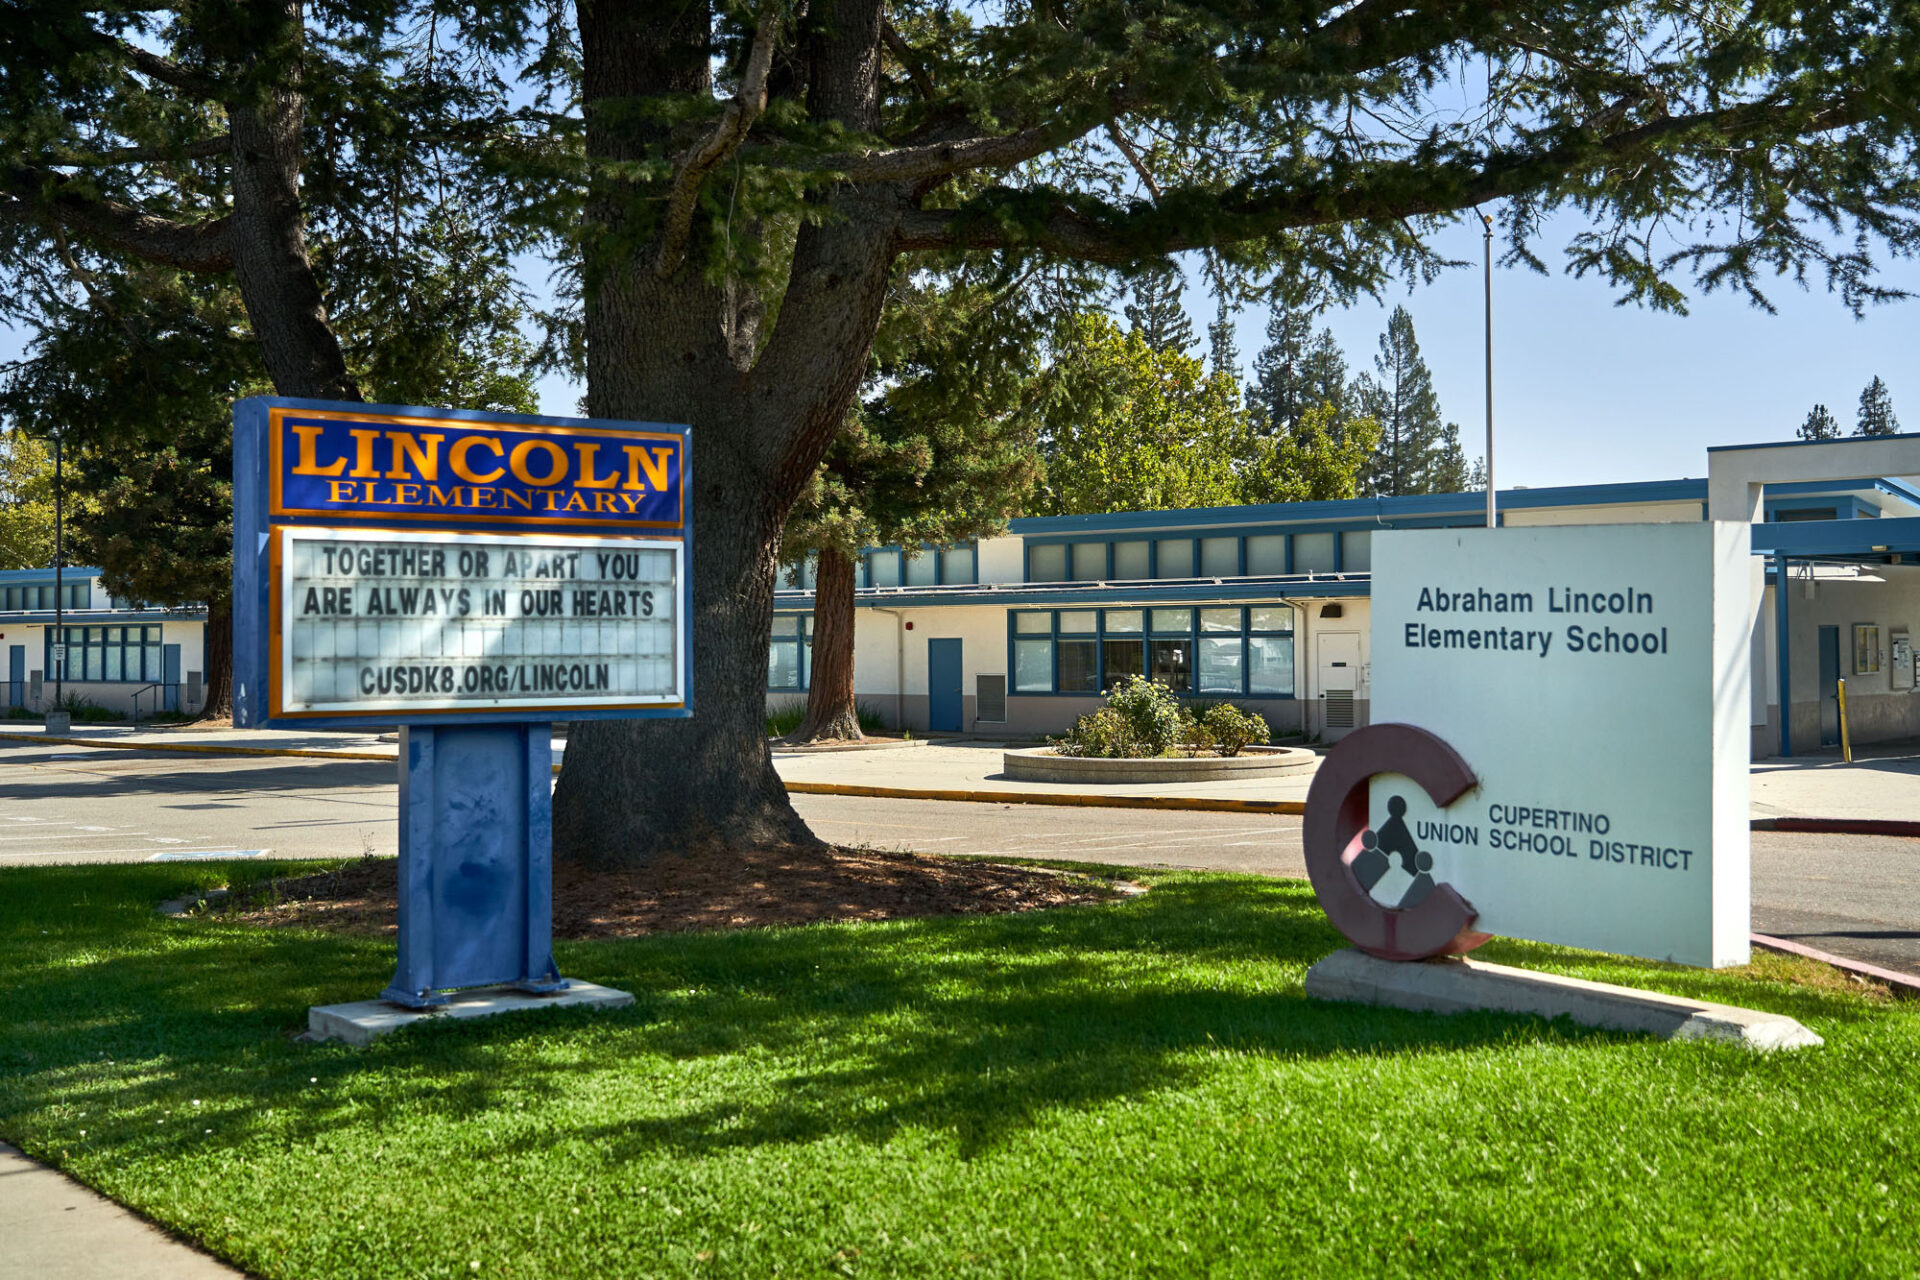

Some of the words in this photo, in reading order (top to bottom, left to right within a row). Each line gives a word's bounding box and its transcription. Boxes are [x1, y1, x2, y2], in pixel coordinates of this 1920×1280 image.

[291, 425, 674, 492] LINCOLN
[325, 480, 647, 514] ELEMENTARY
[323, 547, 446, 577] TOGETHER
[459, 551, 490, 577] OR
[505, 552, 579, 579] APART
[598, 554, 640, 580] YOU
[304, 587, 352, 615] ARE
[367, 587, 471, 616] ALWAYS
[485, 589, 506, 616] IN
[520, 590, 564, 616] OUR
[573, 590, 654, 617] HEARTS
[1417, 587, 1533, 613] Abraham
[1549, 587, 1654, 614] Lincoln
[1405, 623, 1552, 657] Elementary
[1567, 625, 1668, 654] School
[361, 664, 610, 695] CUSDK8.ORG/LINCOLN
[1489, 804, 1611, 835] CUPERTINO
[1417, 821, 1478, 845] UNION
[1489, 829, 1578, 857] SCHOOL
[1589, 841, 1693, 871] DISTRICT
